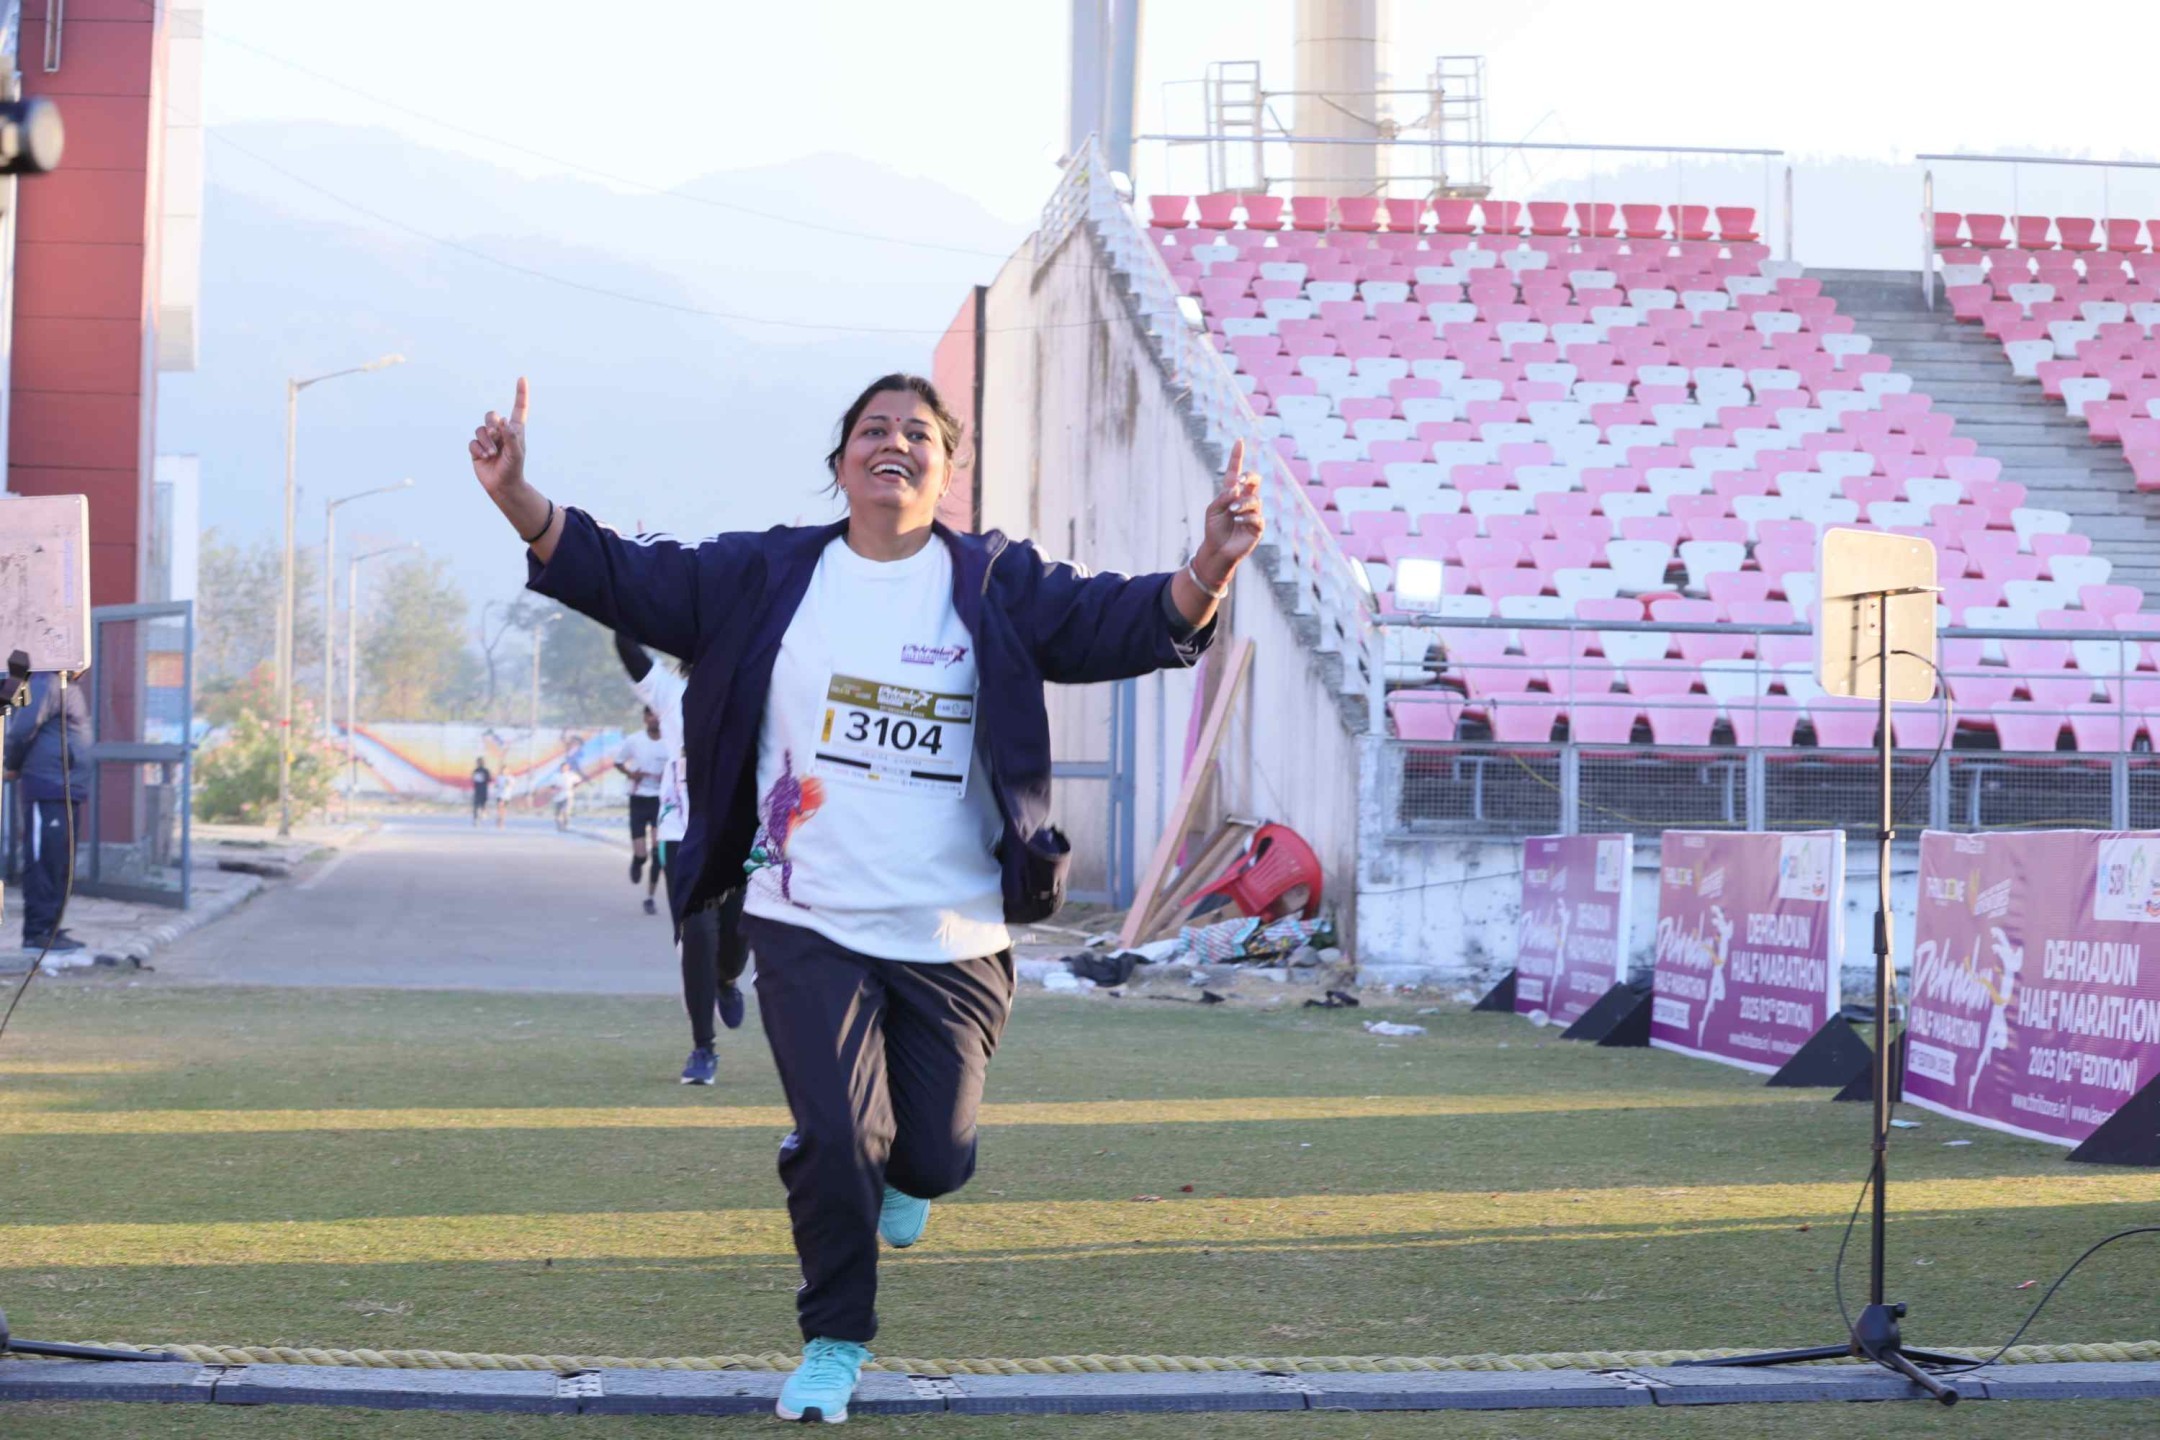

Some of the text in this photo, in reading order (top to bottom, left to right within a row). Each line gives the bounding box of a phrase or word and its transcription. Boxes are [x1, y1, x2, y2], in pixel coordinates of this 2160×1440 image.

[844, 711, 943, 755] 3104
[1747, 913, 1812, 949] DEHRADUN
[1731, 950, 1826, 993] HALF MARATHON
[2043, 939, 2141, 986] DEHRADUN
[1910, 1006, 1982, 1049] HALF MARATHON
[2018, 986, 2160, 1044] HALF MARATHON
[2028, 1046, 2056, 1079] 2025
[2081, 1055, 2138, 1095] EDITION)
